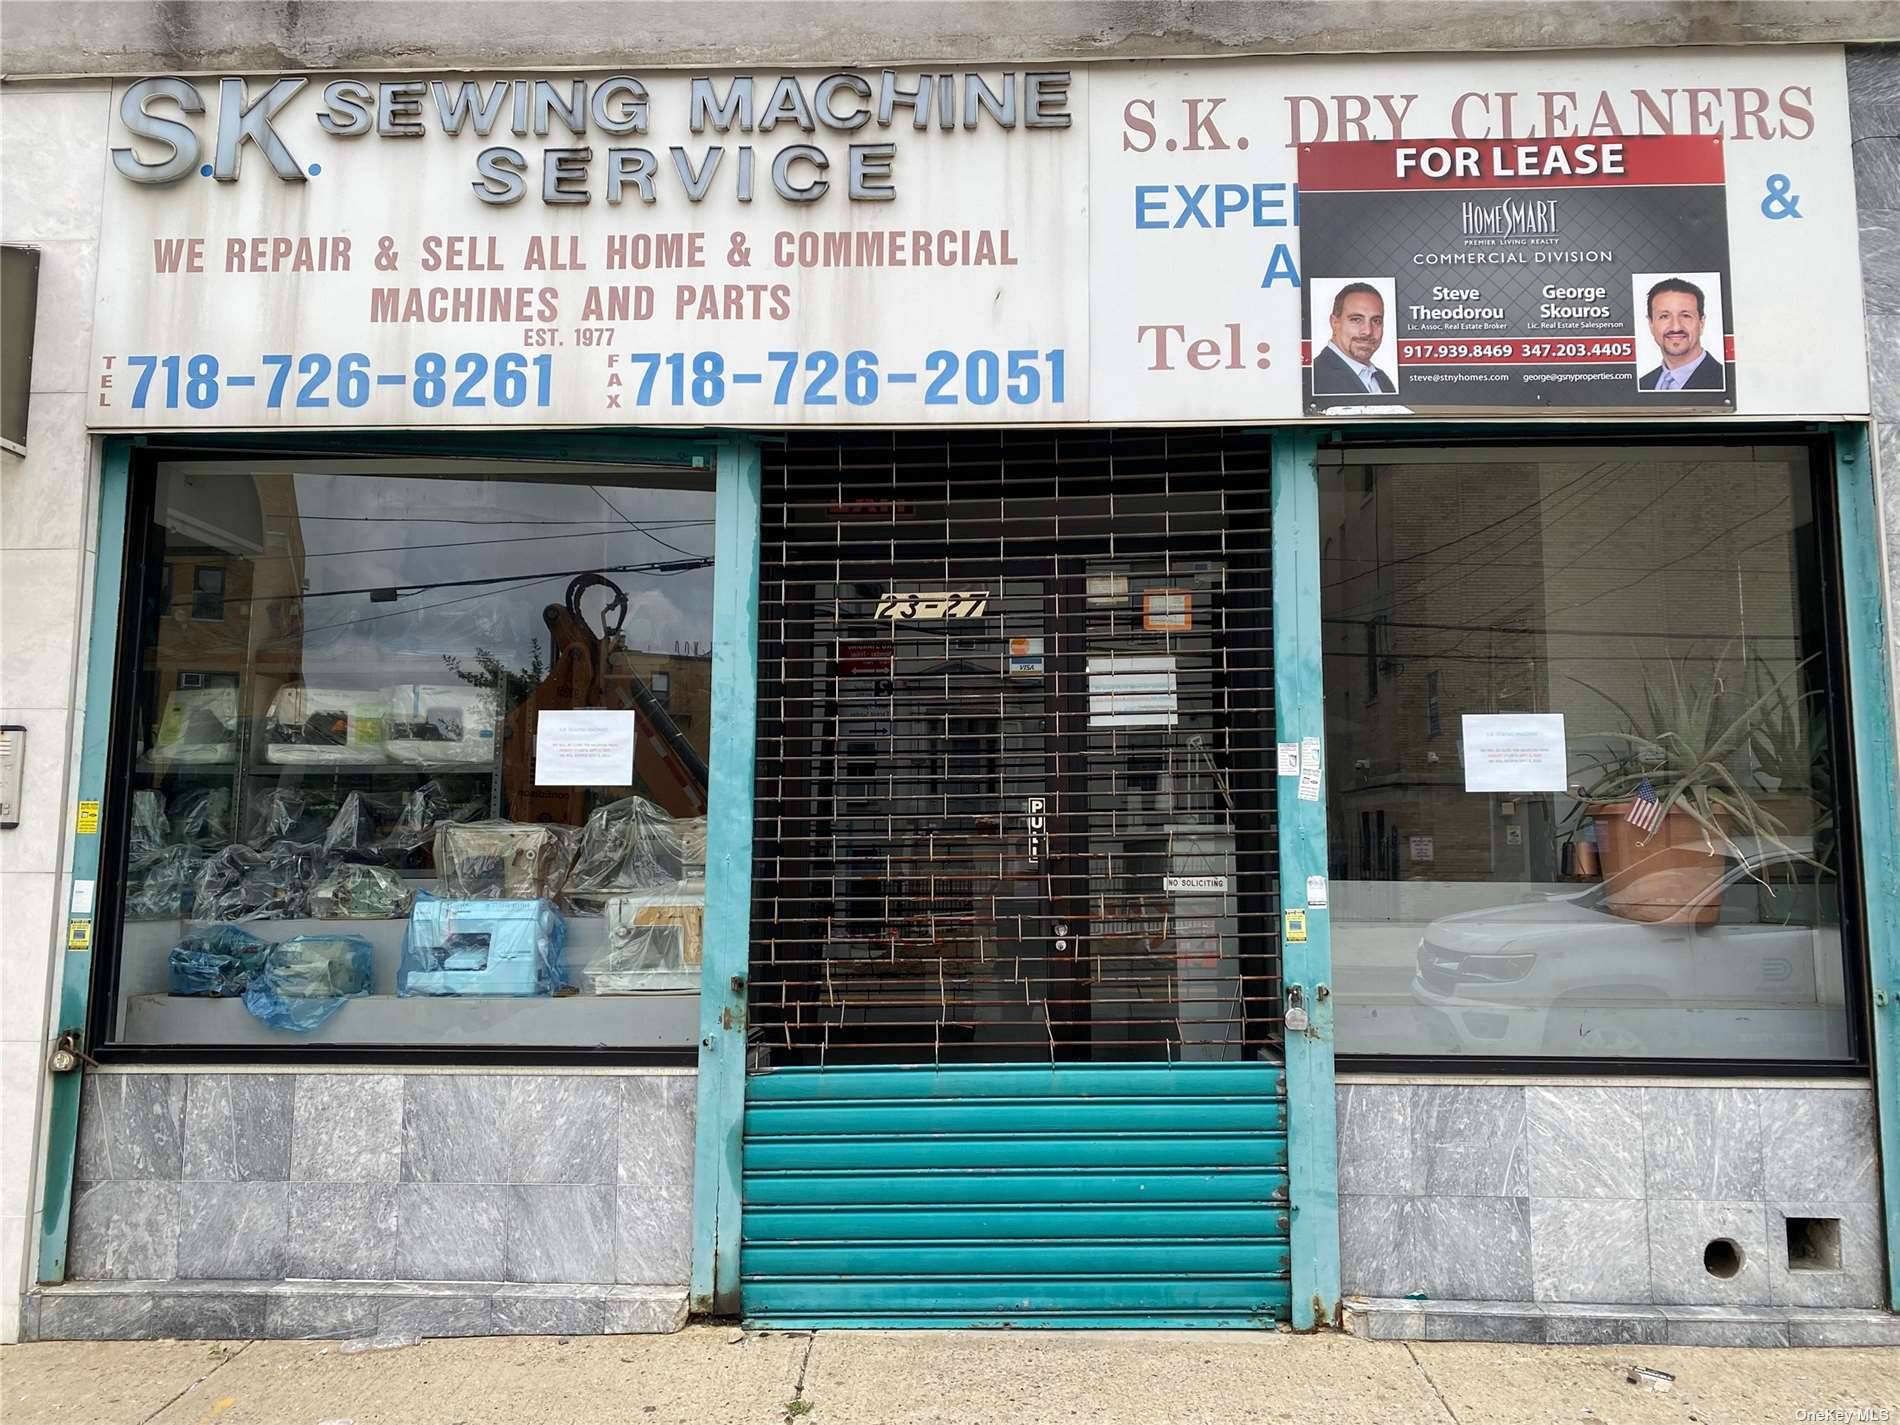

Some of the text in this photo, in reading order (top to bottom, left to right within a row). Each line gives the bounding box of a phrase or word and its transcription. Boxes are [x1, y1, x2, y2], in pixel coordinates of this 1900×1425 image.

[111, 69, 1072, 184] S.K. SEWING MACHINE
[1123, 86, 1815, 152] S.K. DRY CLEANERS
[1395, 143, 1625, 178] FOR LEASE
[471, 142, 897, 205] SERVICE
[1135, 174, 1803, 230] EXPE &
[153, 229, 1018, 273] WE REPAIR & SELL ALL HOME & COMMERCIAL
[1413, 250, 1613, 265] COMMERCIAL DIVISION
[370, 284, 791, 323] MACHINES AND PARTS
[1432, 286, 1481, 300] Steve
[1542, 284, 1606, 302] George
[1409, 304, 1505, 320] Theodorou
[1540, 303, 1610, 318] Skouros
[523, 327, 615, 347] EST. 1977
[1407, 323, 1420, 331] Lic.
[1484, 322, 1507, 330] Broker
[1541, 321, 1556, 329] Real
[1558, 321, 1579, 329] Estate
[1581, 321, 1624, 330] Salesperson
[1137, 323, 1272, 370] Tel:
[1403, 344, 1513, 358] 917.939.8469
[1521, 343, 1632, 357] 347.203.4405
[100, 355, 116, 408] TEL
[127, 352, 552, 409] 718-726-8261
[607, 354, 623, 409] FAX
[631, 349, 1065, 407] 718-726-2051
[1409, 373, 1509, 383] steve@stnyhomes.com
[1523, 372, 1633, 383] george@gsnyproperties.com
[878, 593, 988, 619] 23-27
[1168, 879, 1224, 888] NO SOLICITING
